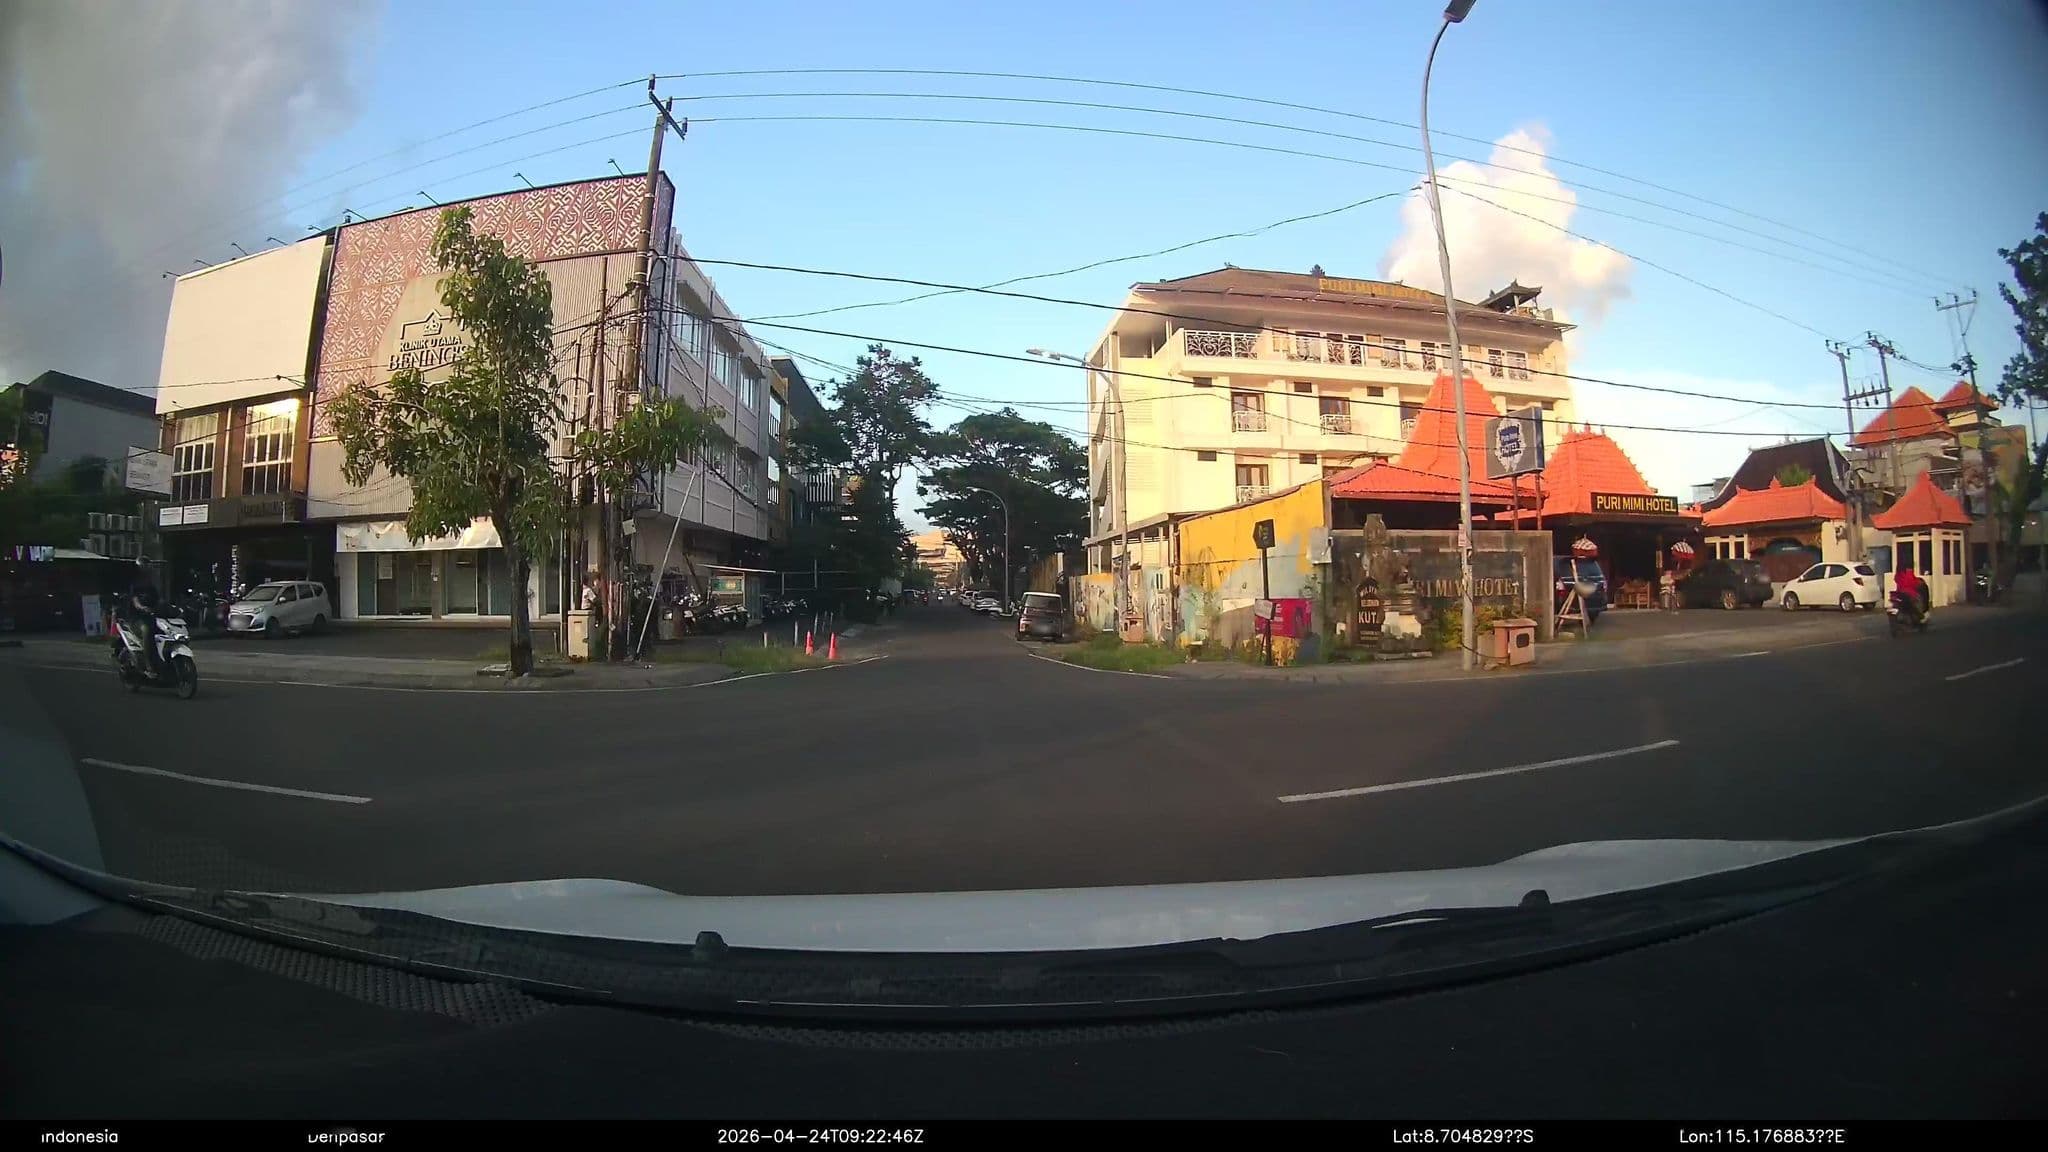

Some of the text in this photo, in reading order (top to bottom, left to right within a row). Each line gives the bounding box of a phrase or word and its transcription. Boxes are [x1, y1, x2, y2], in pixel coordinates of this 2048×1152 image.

[399, 335, 462, 353] KLINIK UTAMA
[1596, 495, 1677, 512] PURI MIMI HOTEL
[1358, 610, 1378, 624] KUT
